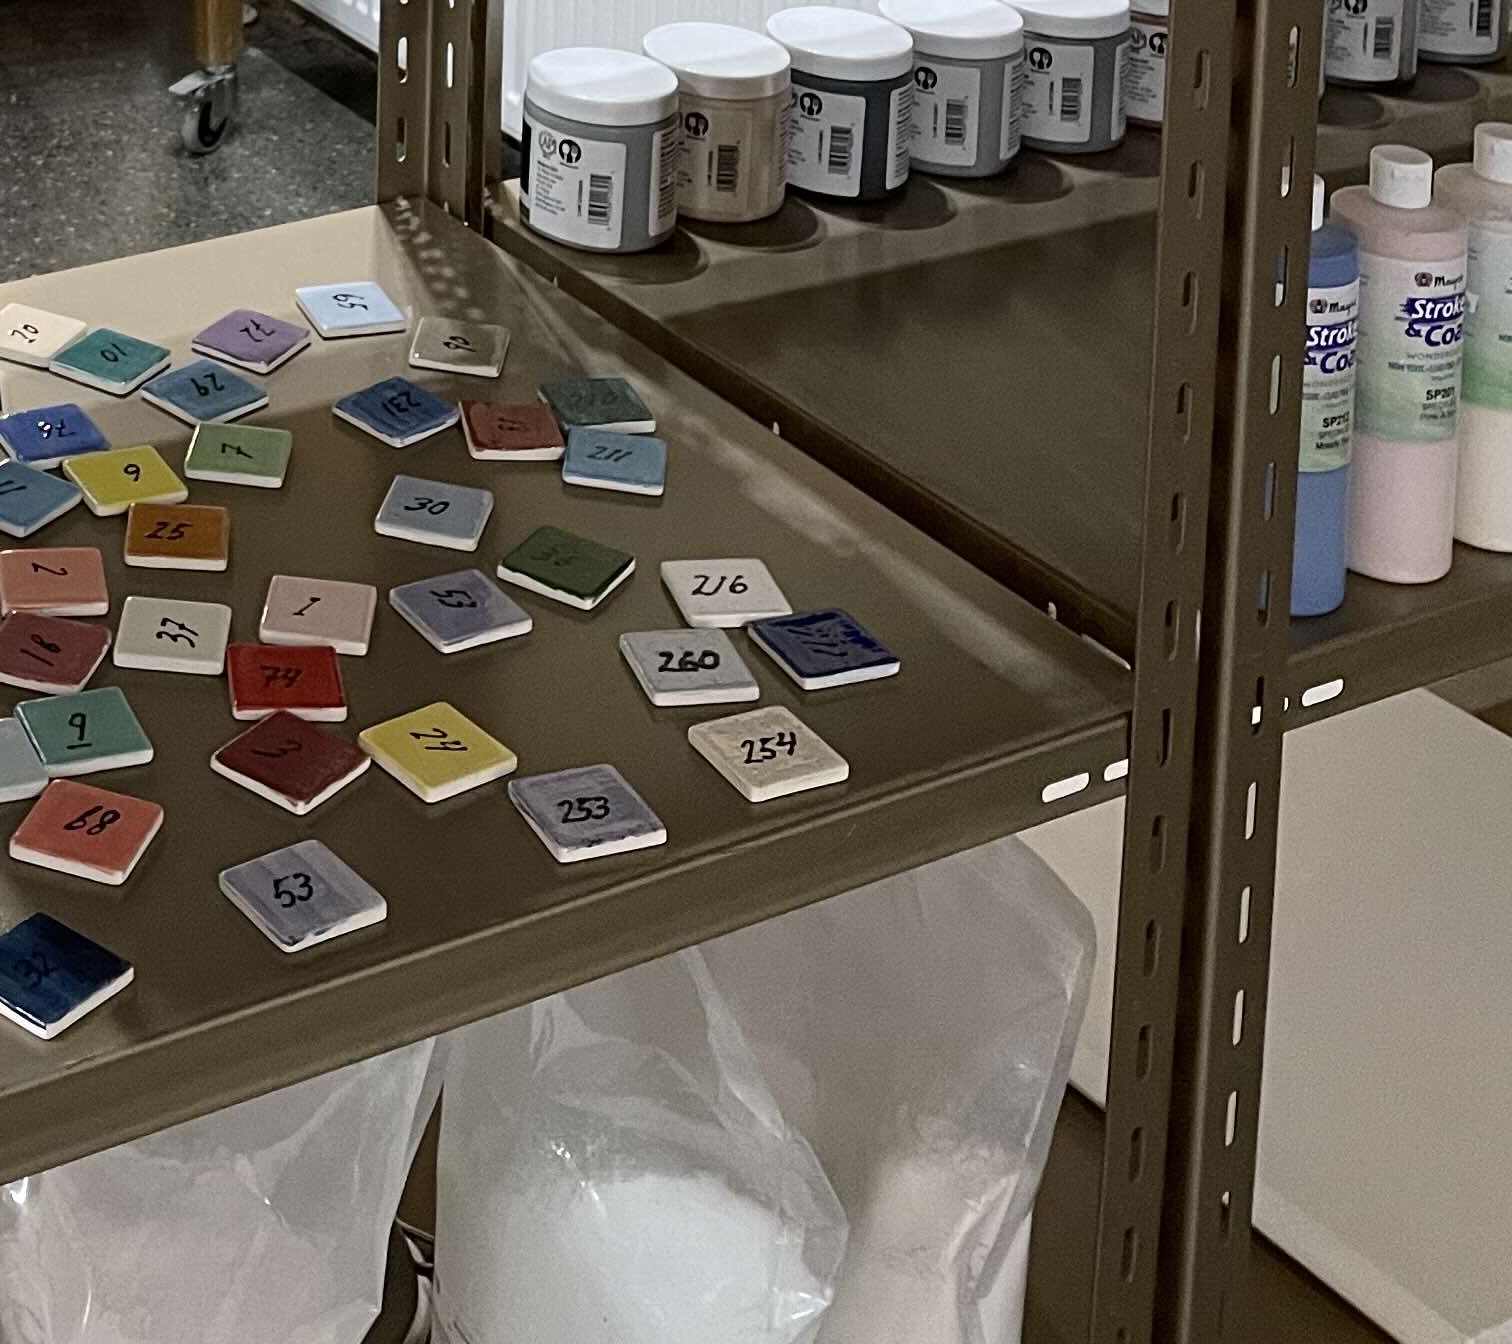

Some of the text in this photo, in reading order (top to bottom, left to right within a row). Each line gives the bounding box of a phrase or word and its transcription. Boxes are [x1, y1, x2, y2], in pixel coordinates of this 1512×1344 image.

[404, 495, 451, 516] 30
[144, 521, 193, 540] 25
[740, 732, 798, 765] 254
[557, 796, 611, 824] 253
[273, 873, 314, 908] 53
